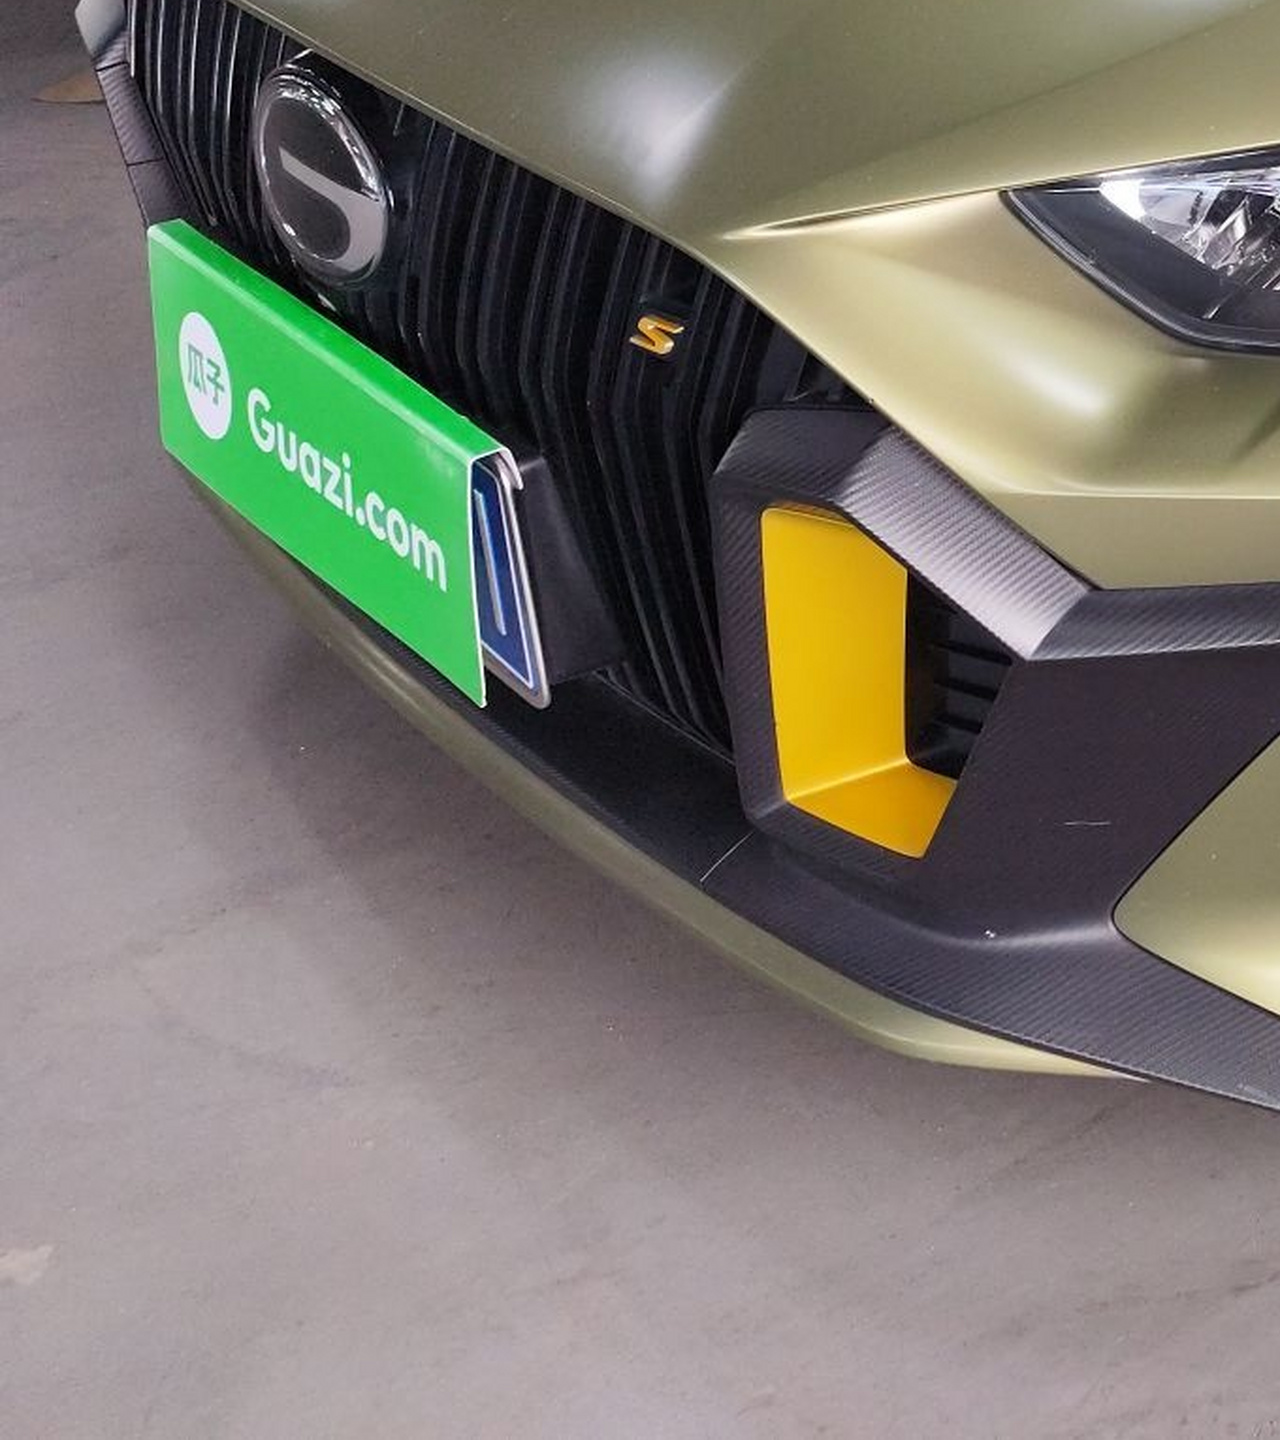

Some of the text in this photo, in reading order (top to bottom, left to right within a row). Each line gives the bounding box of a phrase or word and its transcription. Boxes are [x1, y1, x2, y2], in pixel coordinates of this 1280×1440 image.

[629, 316, 685, 355] S
[187, 343, 225, 405] 瓜子
[247, 387, 447, 593] Guazi.com
